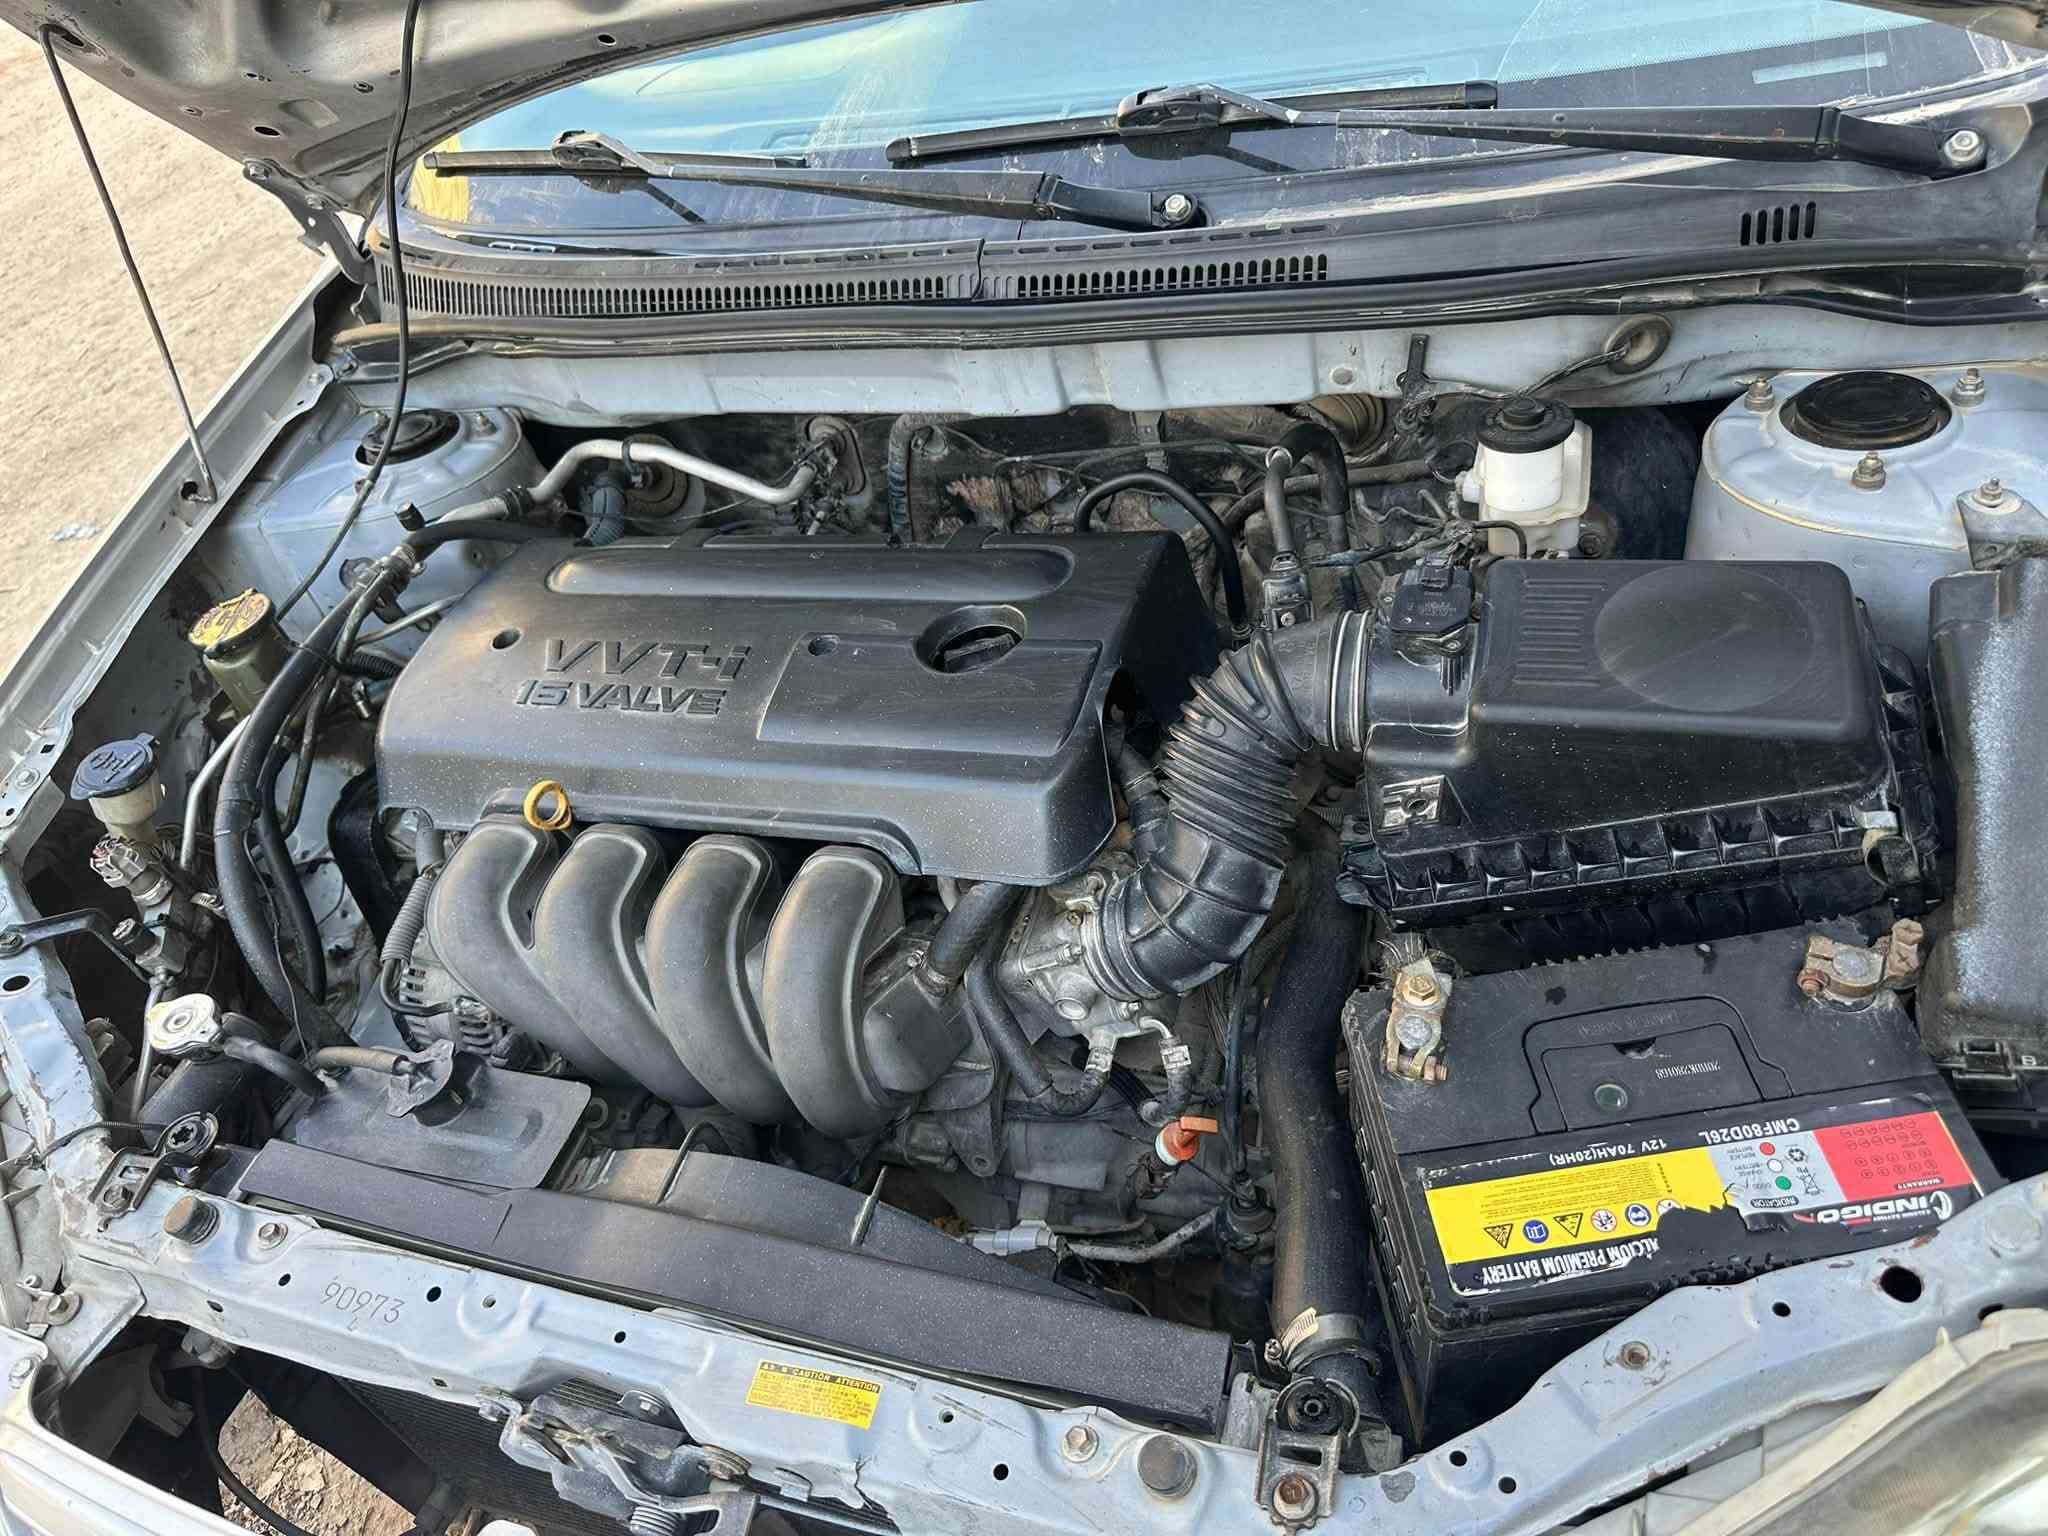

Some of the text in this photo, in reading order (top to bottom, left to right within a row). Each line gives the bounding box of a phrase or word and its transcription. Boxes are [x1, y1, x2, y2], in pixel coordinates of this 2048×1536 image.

[515, 680, 728, 715] 16 VALVE
[1698, 1118, 1801, 1145] CMF80D26L
[1549, 1138, 1668, 1166] 12V 70AH(20HR)
[1752, 1197, 1797, 1208] INDICATOR
[1816, 1196, 1929, 1224] INDIGO
[1481, 1238, 1660, 1285] ALCIUM PREMIUM BATTERY
[320, 1281, 405, 1324] 90973
[793, 1368, 879, 1392] CAUTION ATTENTION
